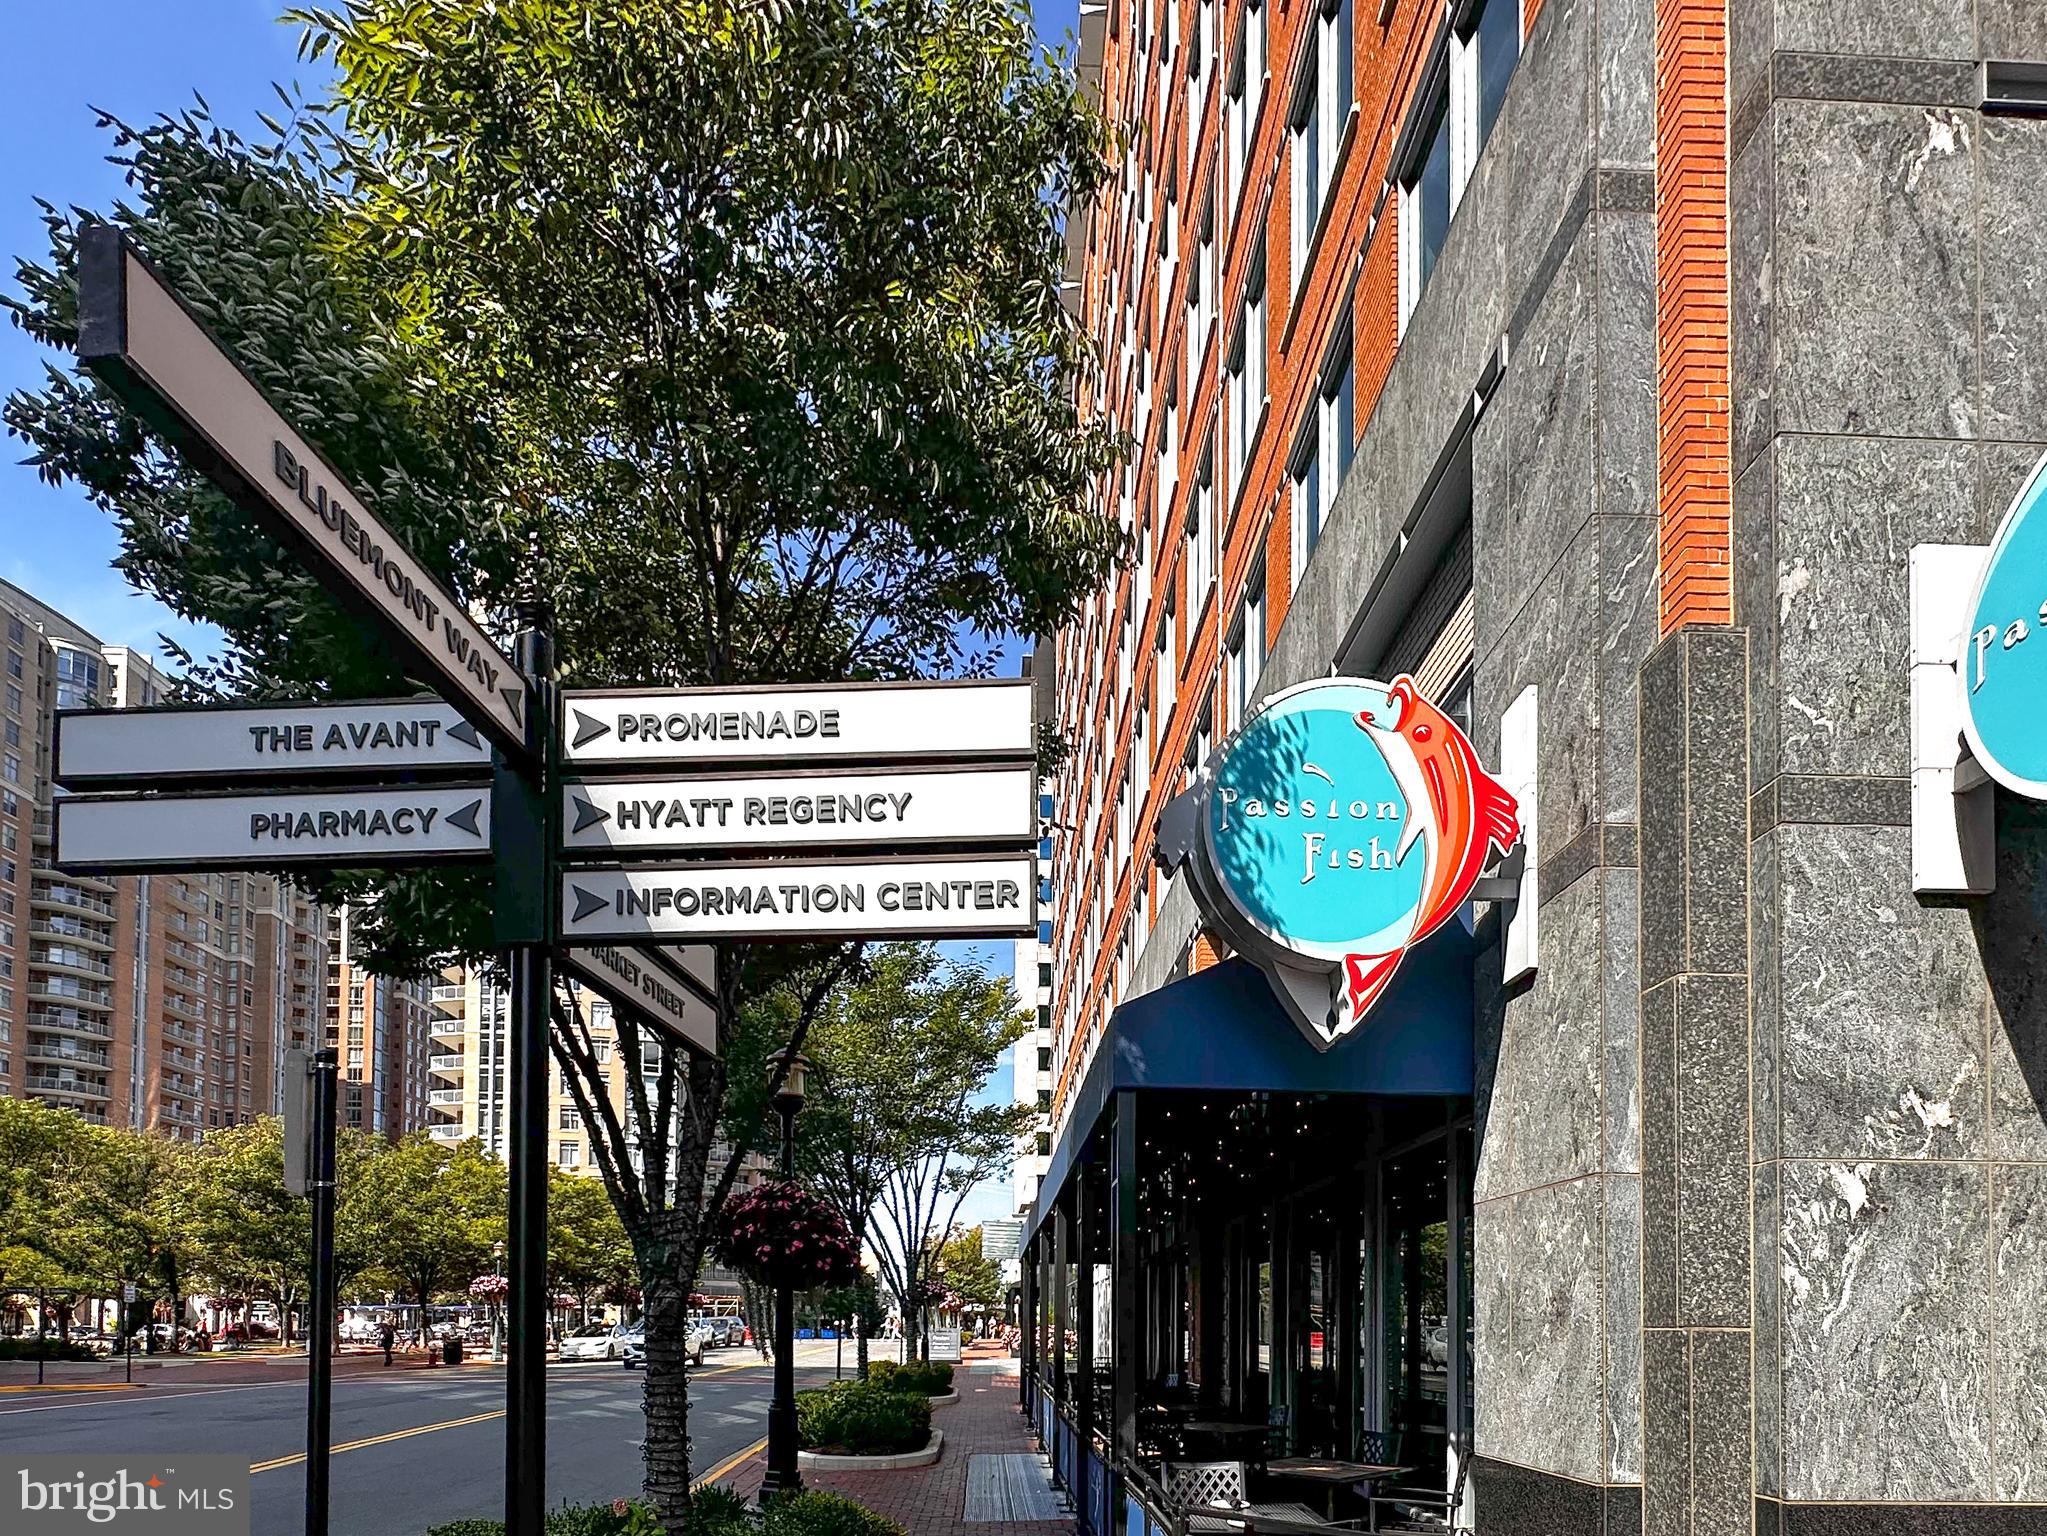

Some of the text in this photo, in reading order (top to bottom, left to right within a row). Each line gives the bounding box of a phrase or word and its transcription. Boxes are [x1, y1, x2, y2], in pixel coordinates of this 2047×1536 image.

[274, 440, 498, 693] BLUEMONT WAY
[250, 720, 440, 752] THE AVANT
[617, 709, 840, 742] PROMENADE
[250, 807, 438, 839] PHARMACY
[617, 792, 912, 830] HYATT REGENCY
[1218, 787, 1400, 831] Passion
[1300, 832, 1393, 884] Fish
[616, 879, 1019, 917] INFORMATION CENTER
[642, 973, 685, 1018] STREET
